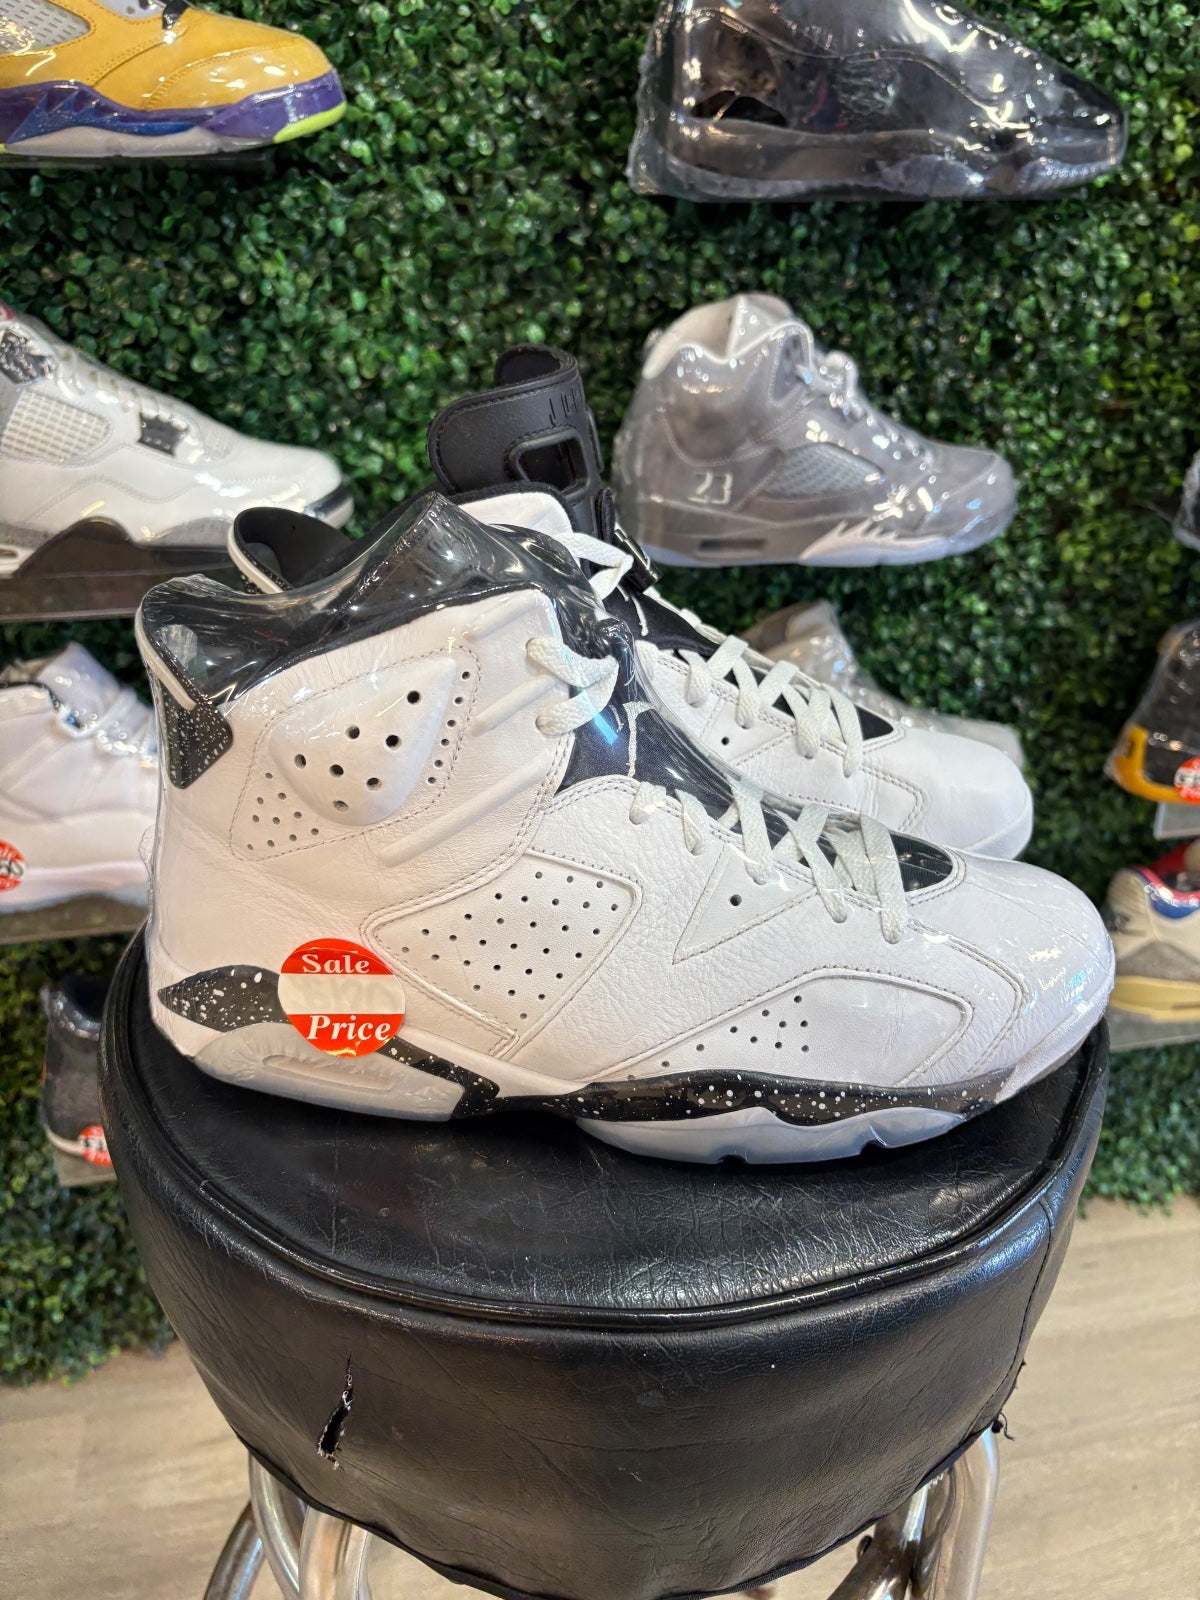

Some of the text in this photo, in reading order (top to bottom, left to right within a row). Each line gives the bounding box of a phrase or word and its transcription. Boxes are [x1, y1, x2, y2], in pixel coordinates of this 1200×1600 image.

[687, 470, 733, 505] 23
[301, 953, 370, 974] Sale
[307, 1014, 391, 1041] Price
